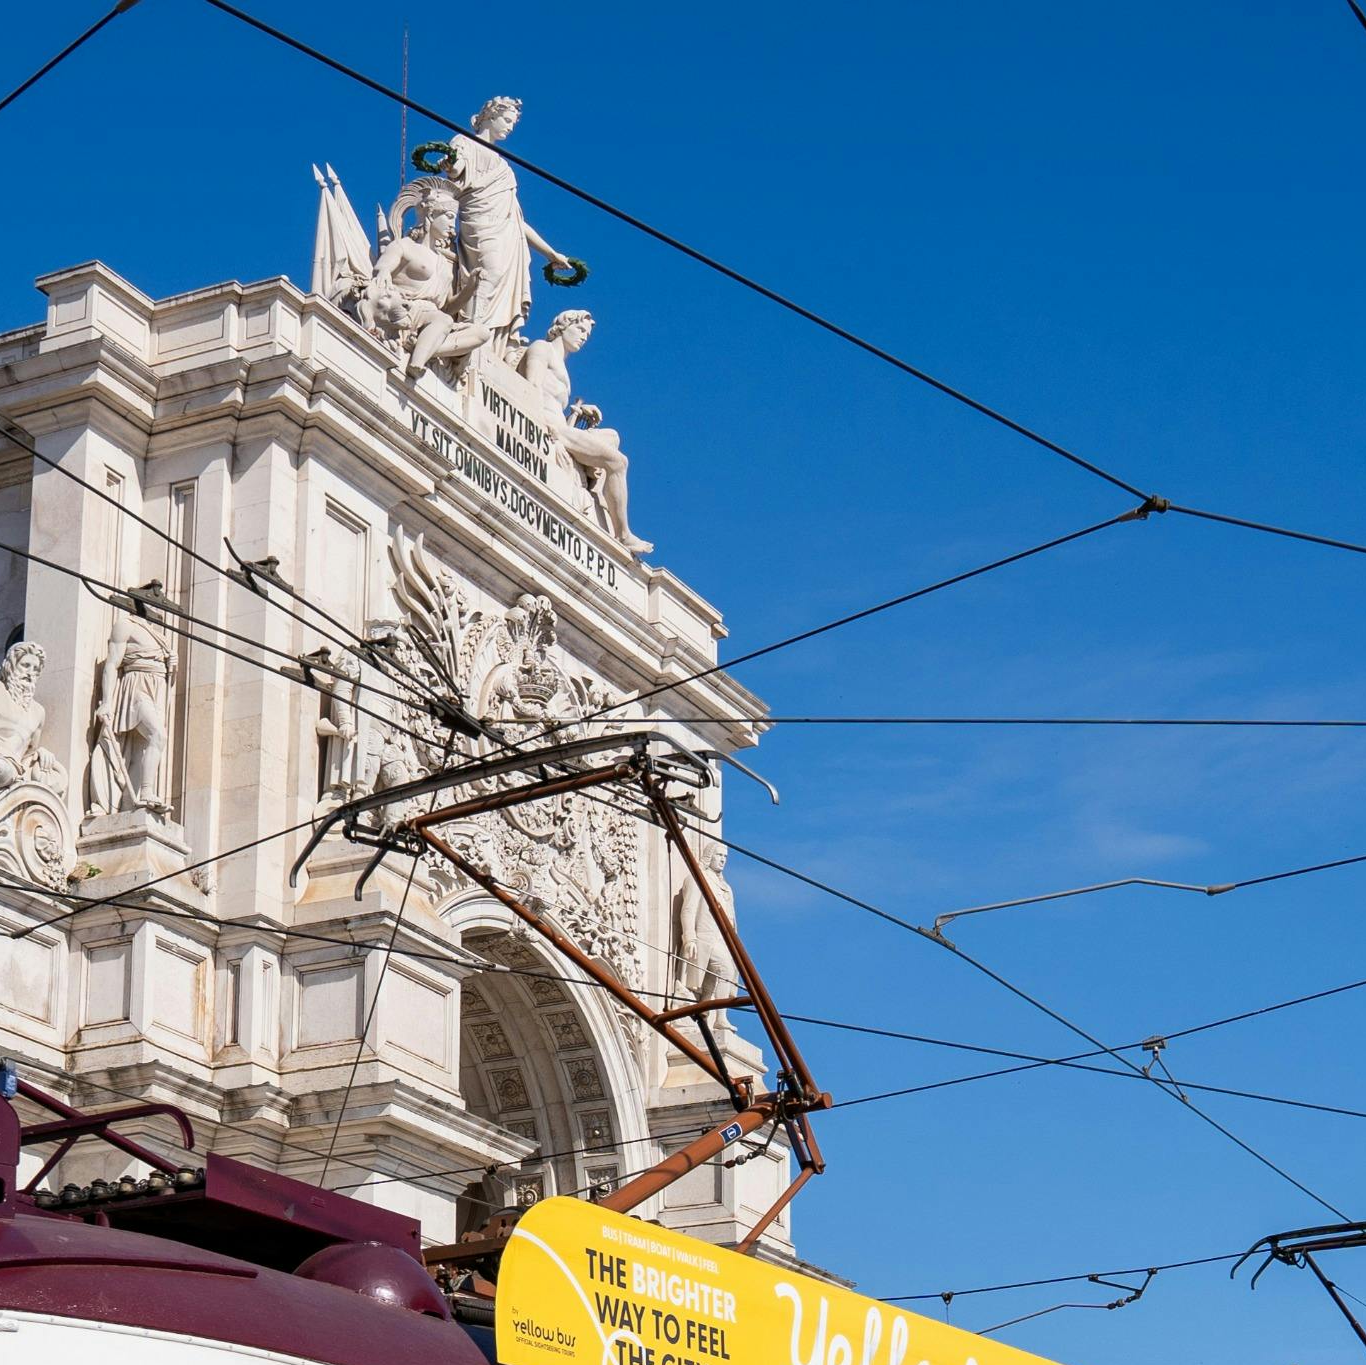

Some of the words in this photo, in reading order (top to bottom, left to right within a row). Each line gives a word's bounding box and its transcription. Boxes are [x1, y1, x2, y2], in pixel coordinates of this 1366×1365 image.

[481, 380, 550, 455] VIRTVTIBVS
[496, 424, 548, 484] MAIORVM
[586, 1247, 627, 1289] THE
[632, 1262, 737, 1323] BRIGHTER
[557, 1327, 576, 1347] bus
[595, 1292, 645, 1335] WAY
[652, 1309, 681, 1345] TO
[686, 1319, 731, 1360] FEEL
